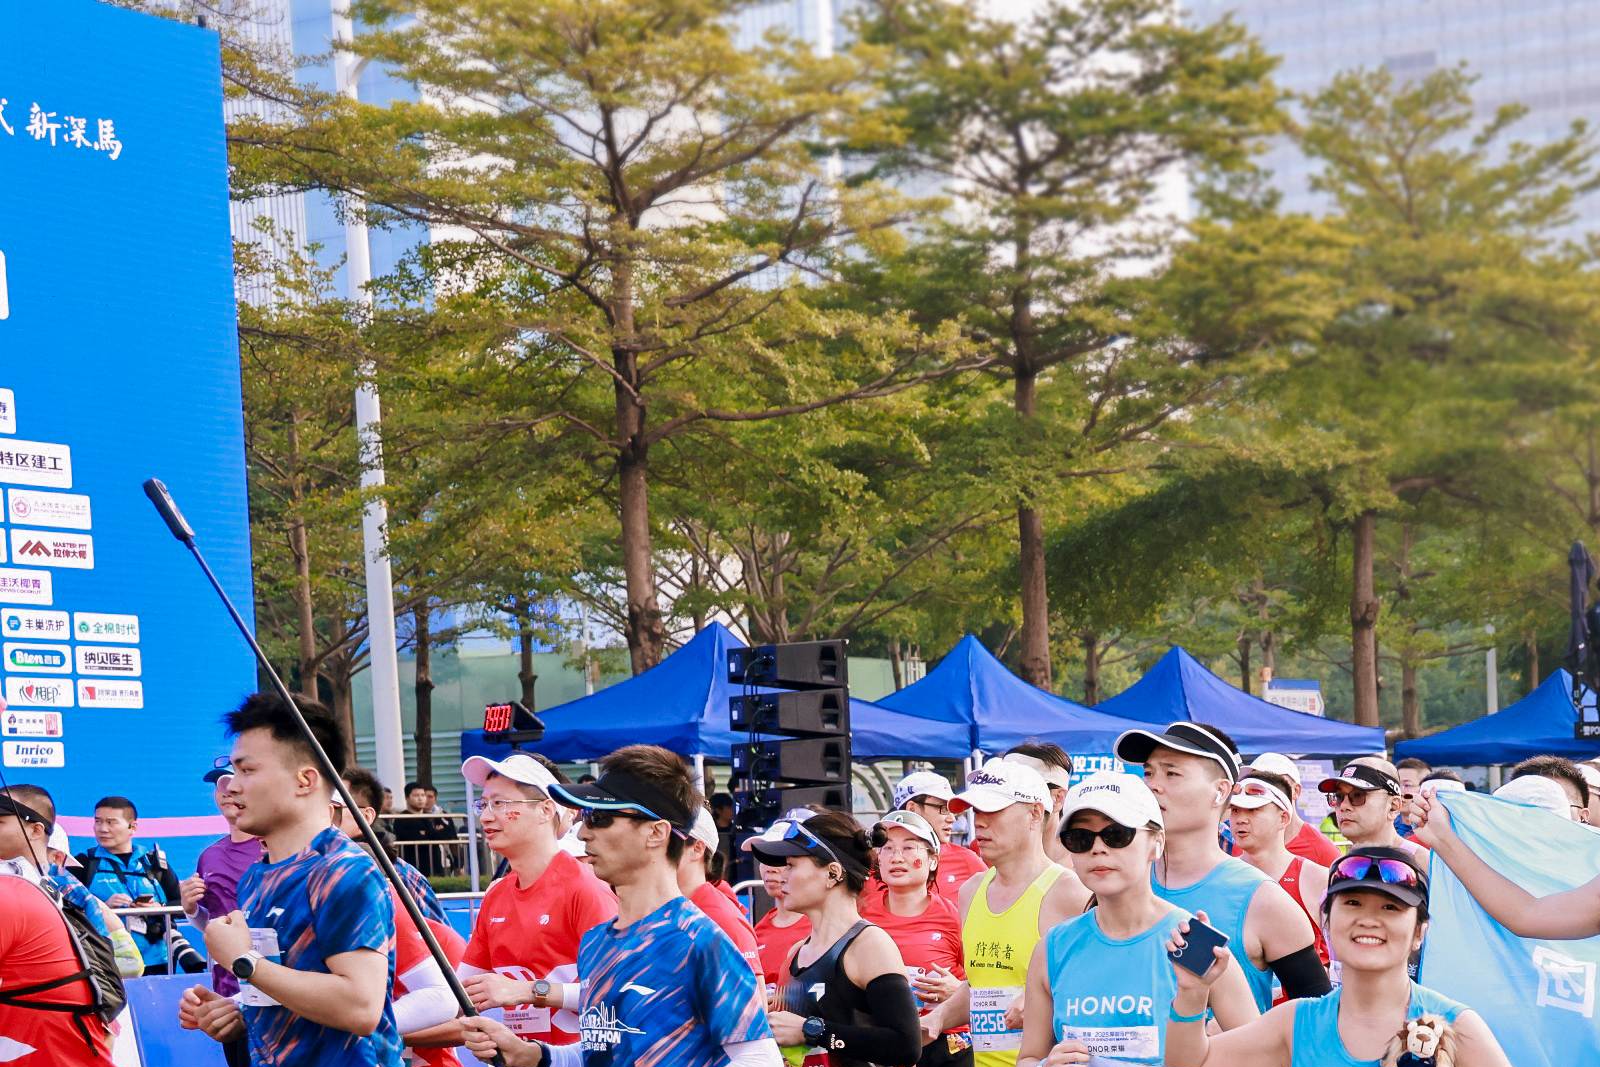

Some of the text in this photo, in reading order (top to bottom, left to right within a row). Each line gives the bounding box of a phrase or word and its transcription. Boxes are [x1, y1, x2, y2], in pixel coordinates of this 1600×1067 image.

[84, 652, 133, 666] 纳贝医生
[15, 745, 53, 755] Inrico
[1066, 996, 1153, 1016] HONOR
[1088, 1045, 1109, 1053] ONOR
